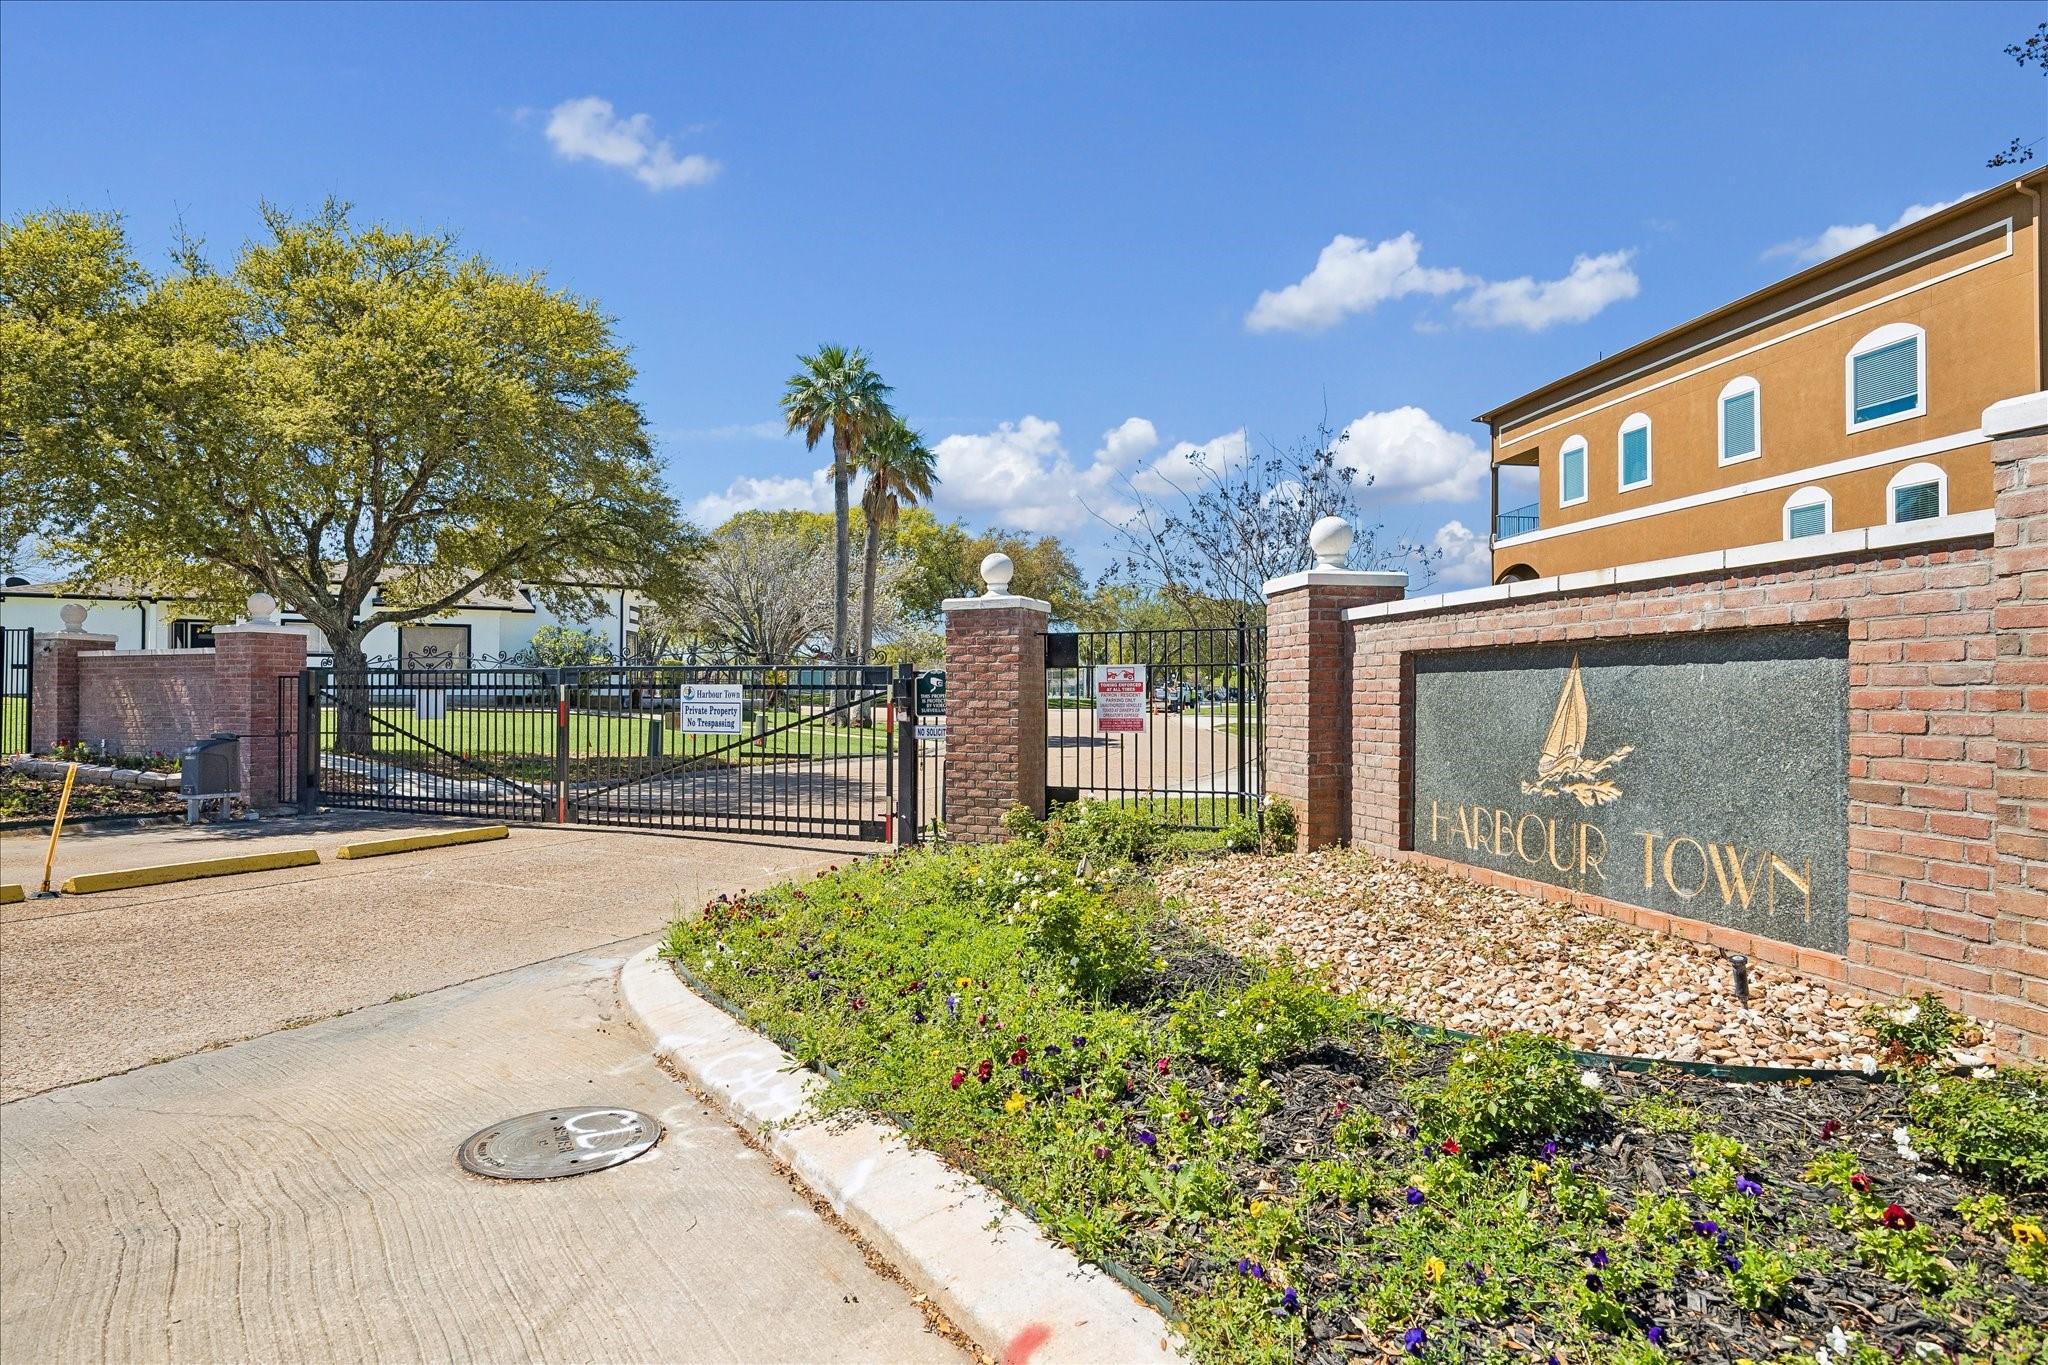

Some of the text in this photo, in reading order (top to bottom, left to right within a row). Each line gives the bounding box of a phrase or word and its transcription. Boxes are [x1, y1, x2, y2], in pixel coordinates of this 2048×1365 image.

[697, 690, 740, 699] Harbour Town
[685, 706, 737, 716] Private Property
[687, 718, 735, 729] No Trespassing
[918, 728, 925, 736] NO
[1431, 800, 1811, 923] HARBOUR TOWN
